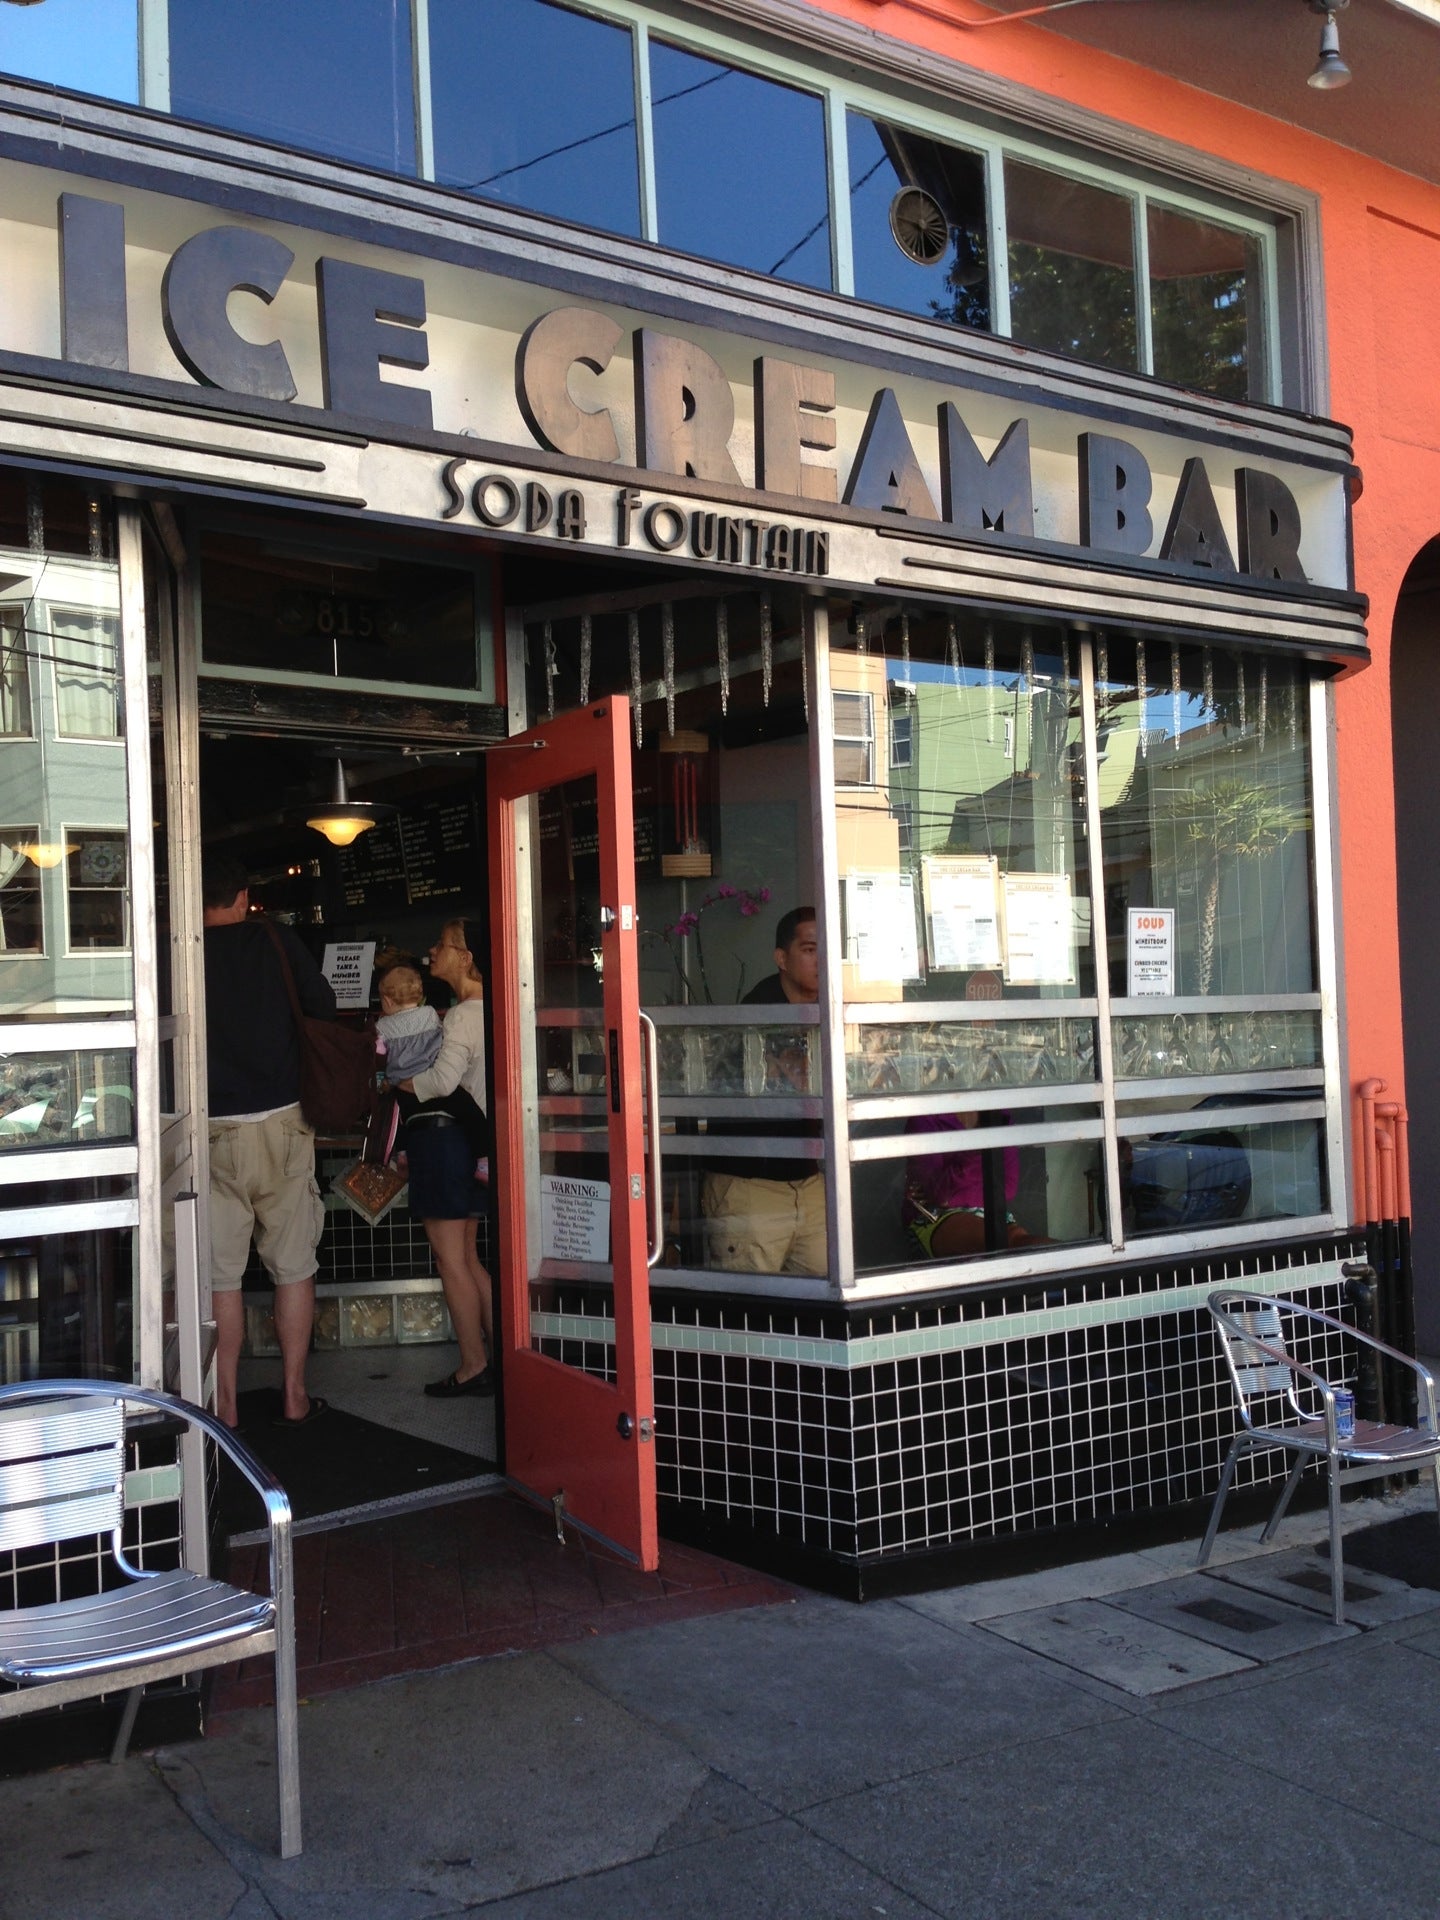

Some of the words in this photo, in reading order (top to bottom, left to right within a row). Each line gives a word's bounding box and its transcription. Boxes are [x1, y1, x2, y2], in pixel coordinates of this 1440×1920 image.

[58, 191, 434, 431] ICE
[515, 306, 1035, 538] CREAM
[1077, 431, 1310, 581] BAR
[442, 457, 588, 540] SODA
[617, 487, 830, 576] FOUNTAIN
[317, 600, 374, 637] 815
[1138, 917, 1164, 929] SOUP
[551, 1181, 599, 1197] WARNING:
[555, 1197, 573, 1206] Drinking
[574, 1199, 593, 1208] Distilled
[556, 1212, 568, 1220] Wine
[577, 1214, 591, 1223] Other
